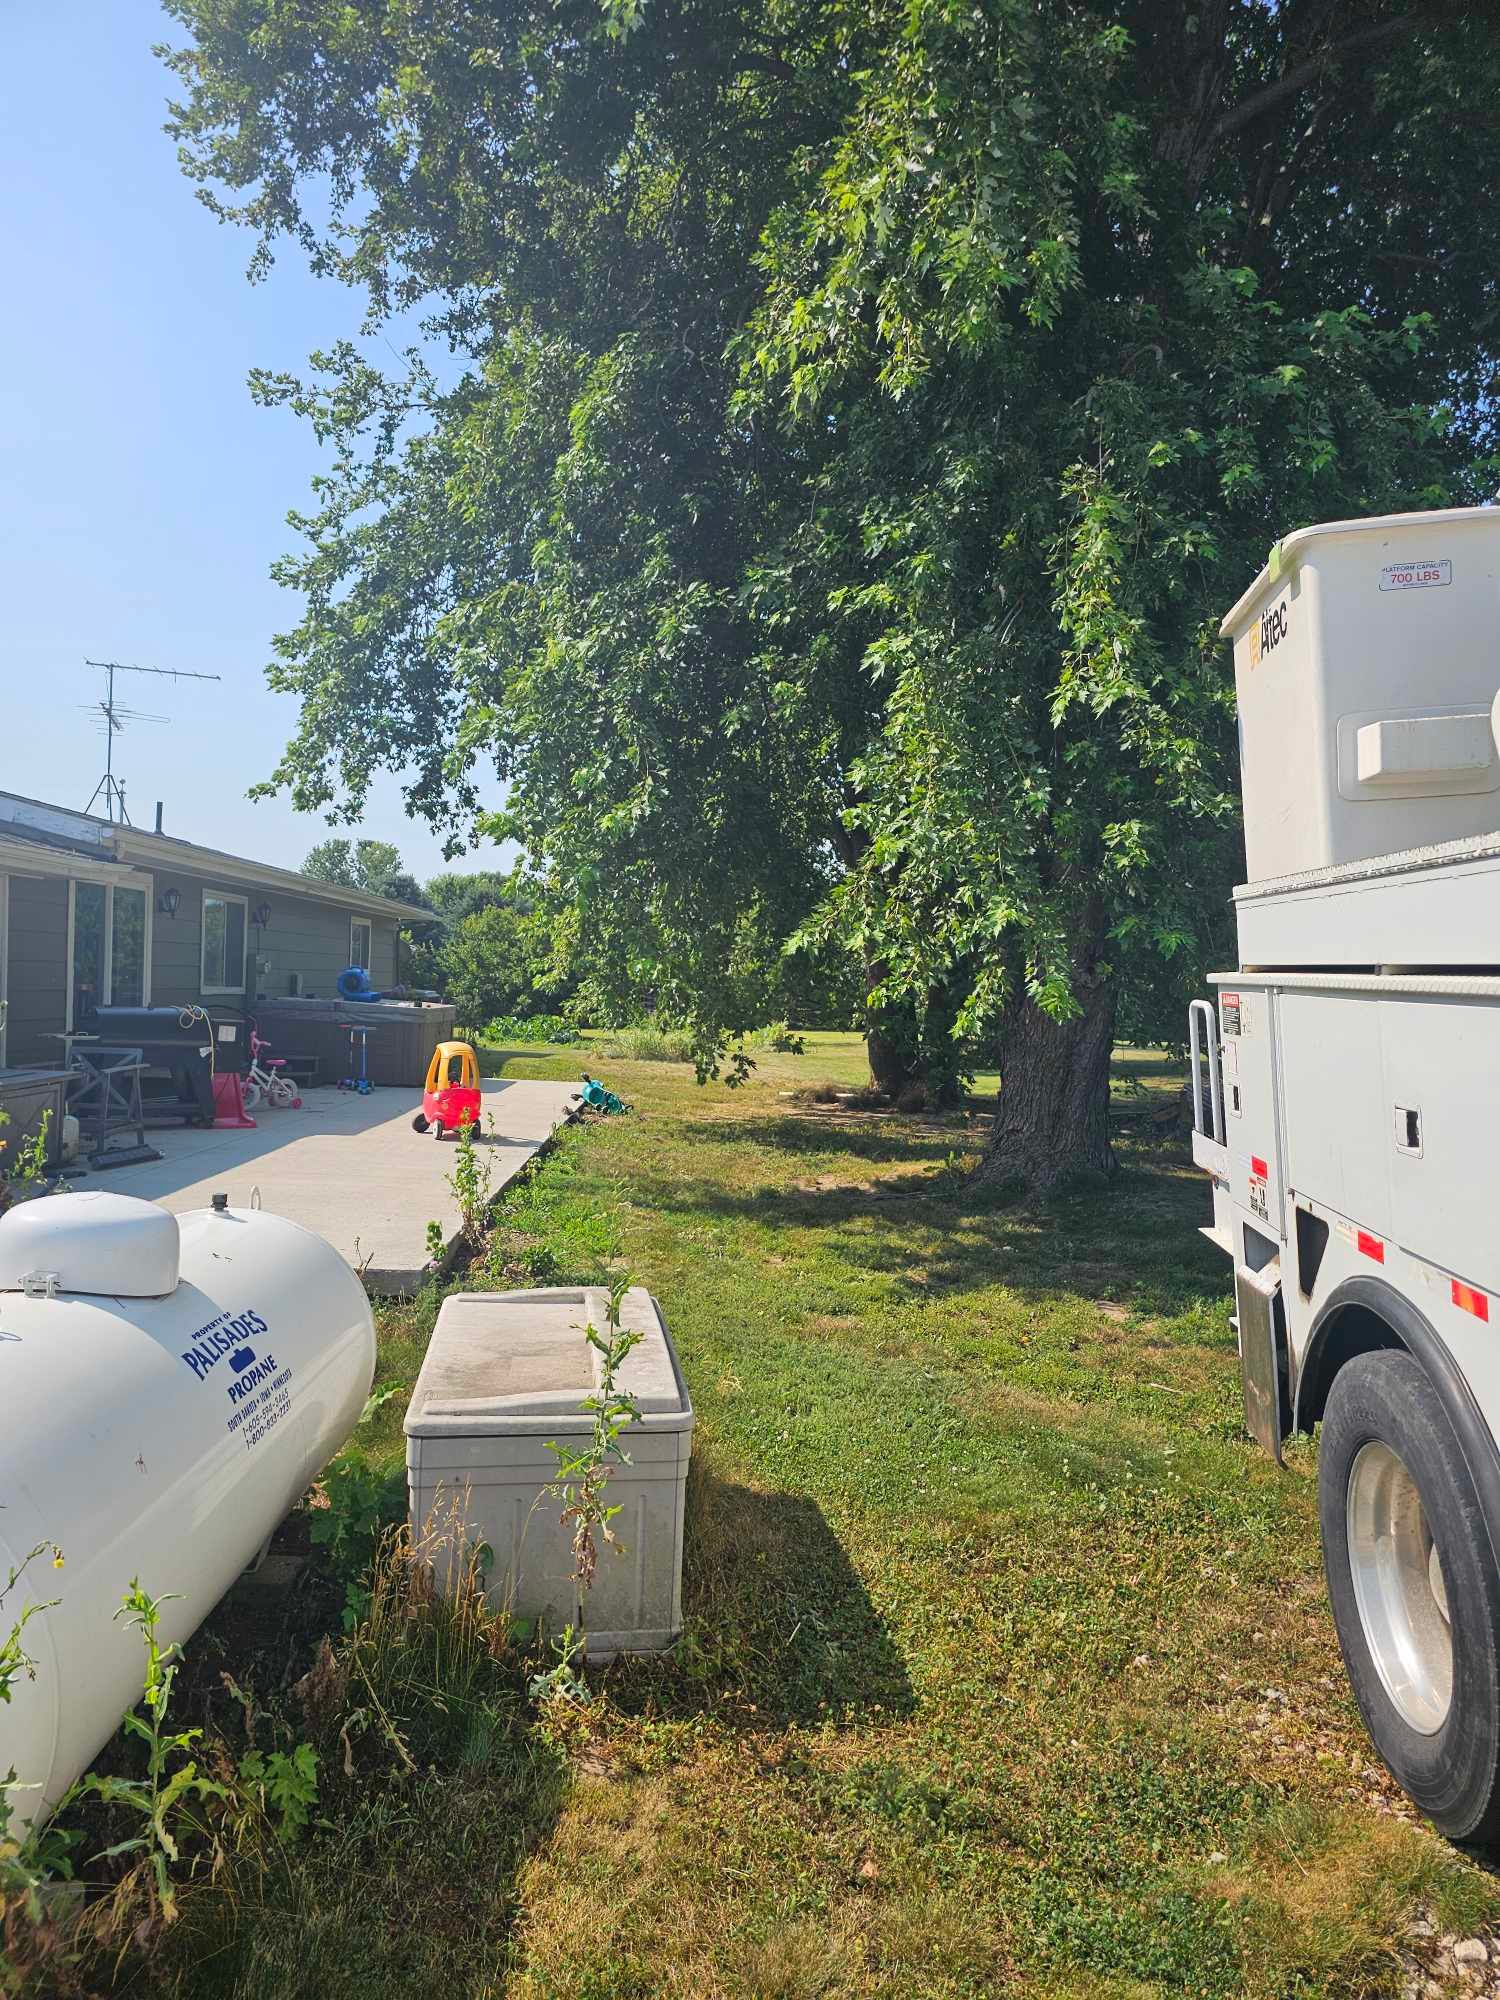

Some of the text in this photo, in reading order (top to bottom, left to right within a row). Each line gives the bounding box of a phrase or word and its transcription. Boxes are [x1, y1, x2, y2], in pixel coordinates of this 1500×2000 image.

[1391, 570, 1440, 584] 700 LBS
[181, 1309, 268, 1382] PALISADES
[191, 1311, 232, 1341] PROPERTY OF
[227, 1354, 278, 1405] PROPANE
